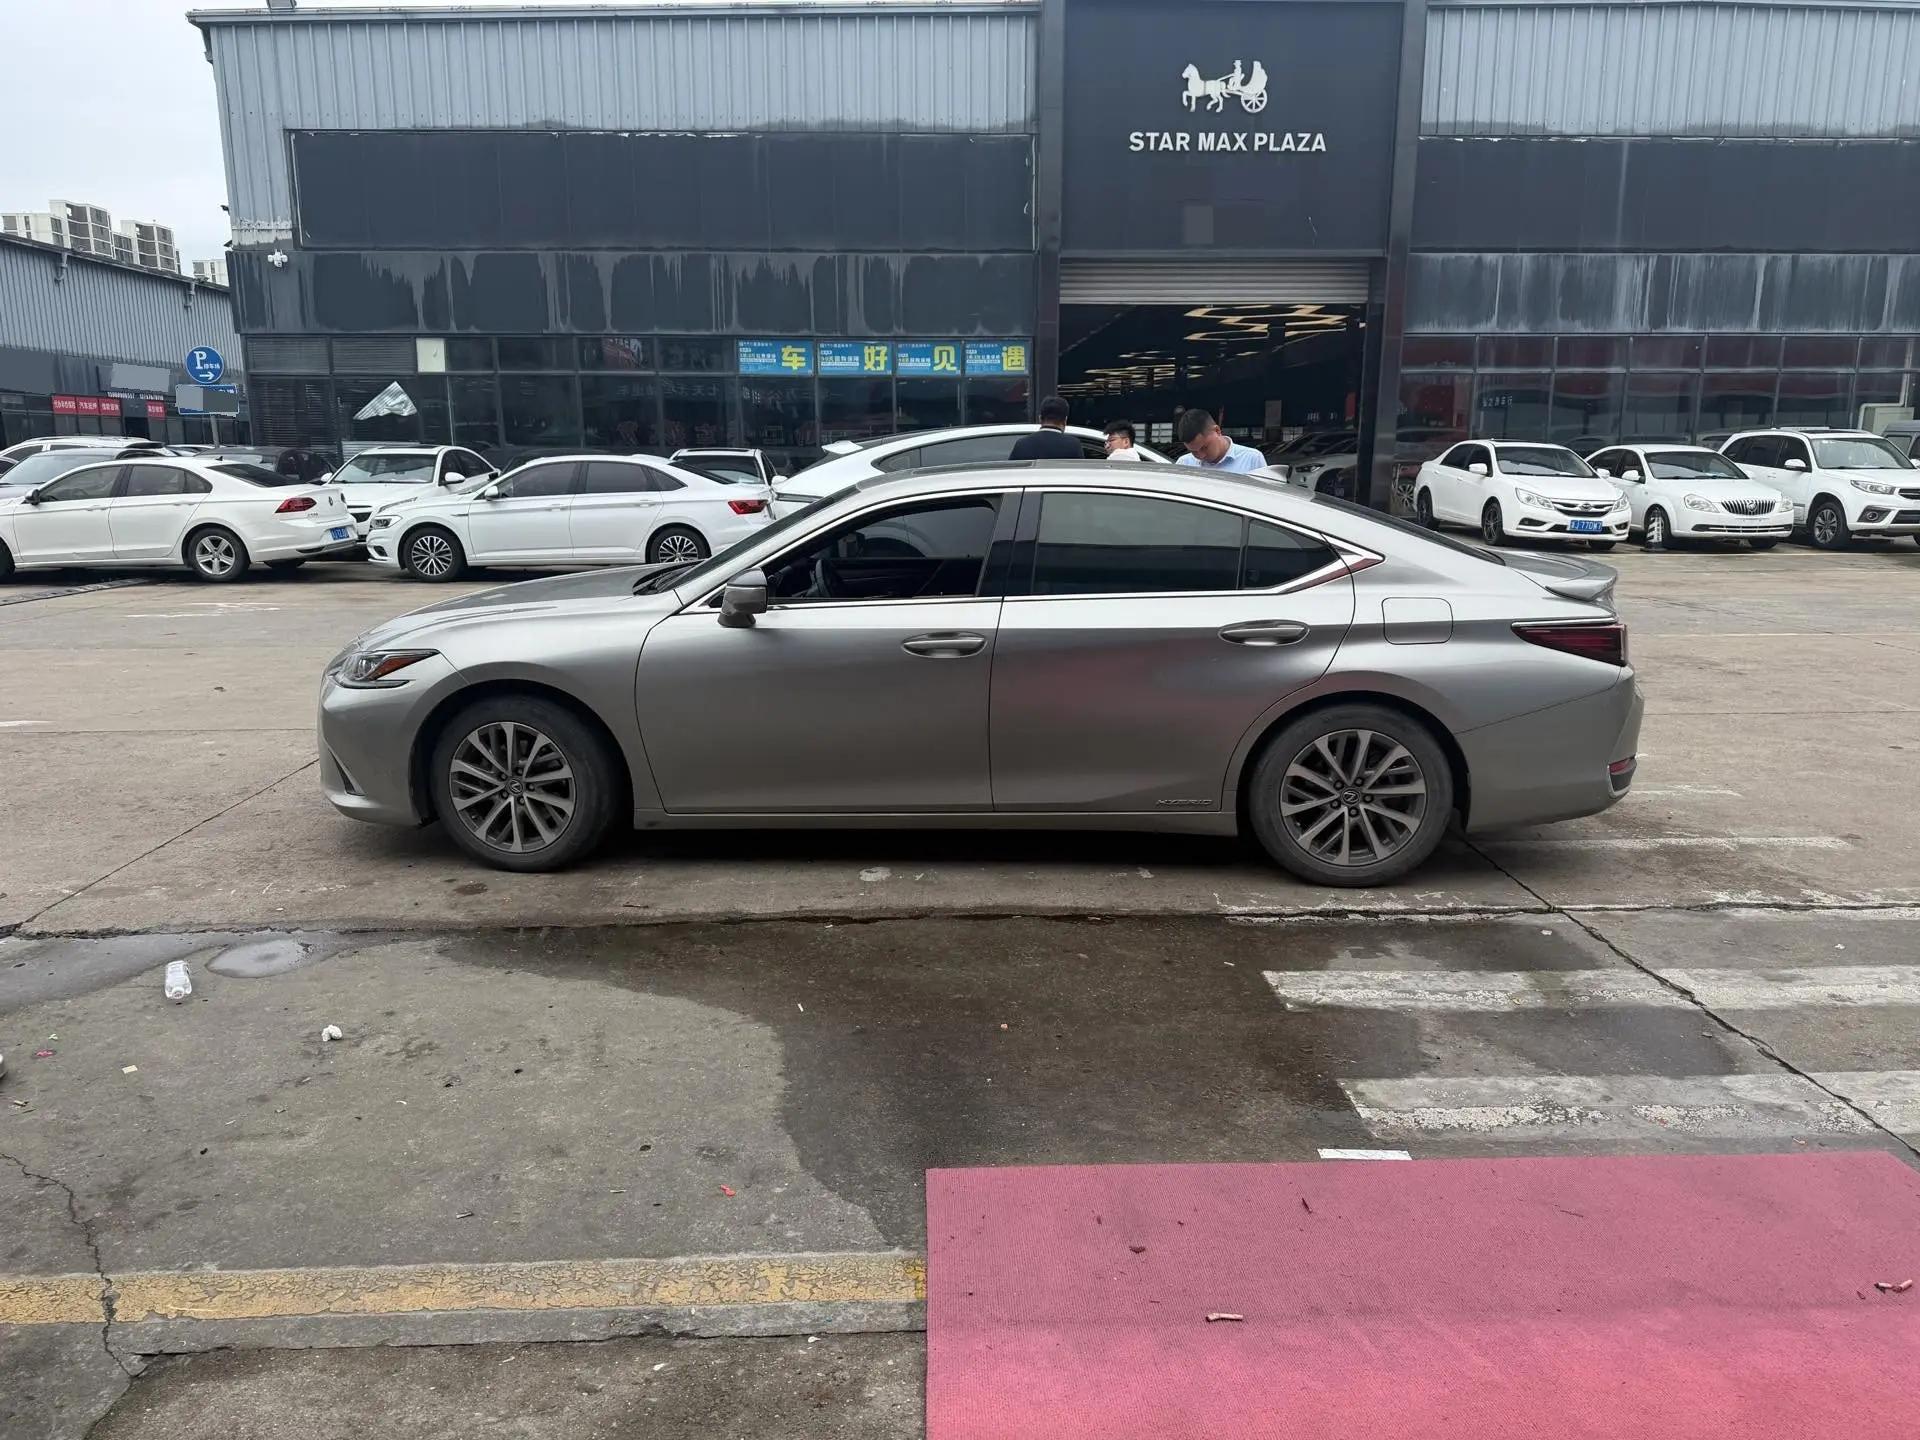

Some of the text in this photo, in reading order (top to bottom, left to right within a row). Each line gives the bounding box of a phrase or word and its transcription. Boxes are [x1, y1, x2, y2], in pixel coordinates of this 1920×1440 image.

[1129, 131, 1327, 152] STAR MAX PLAZA
[194, 351, 207, 370] P
[781, 345, 806, 371] 车
[864, 345, 888, 371] 好
[933, 345, 958, 371] 见
[1001, 346, 1025, 371] 遇
